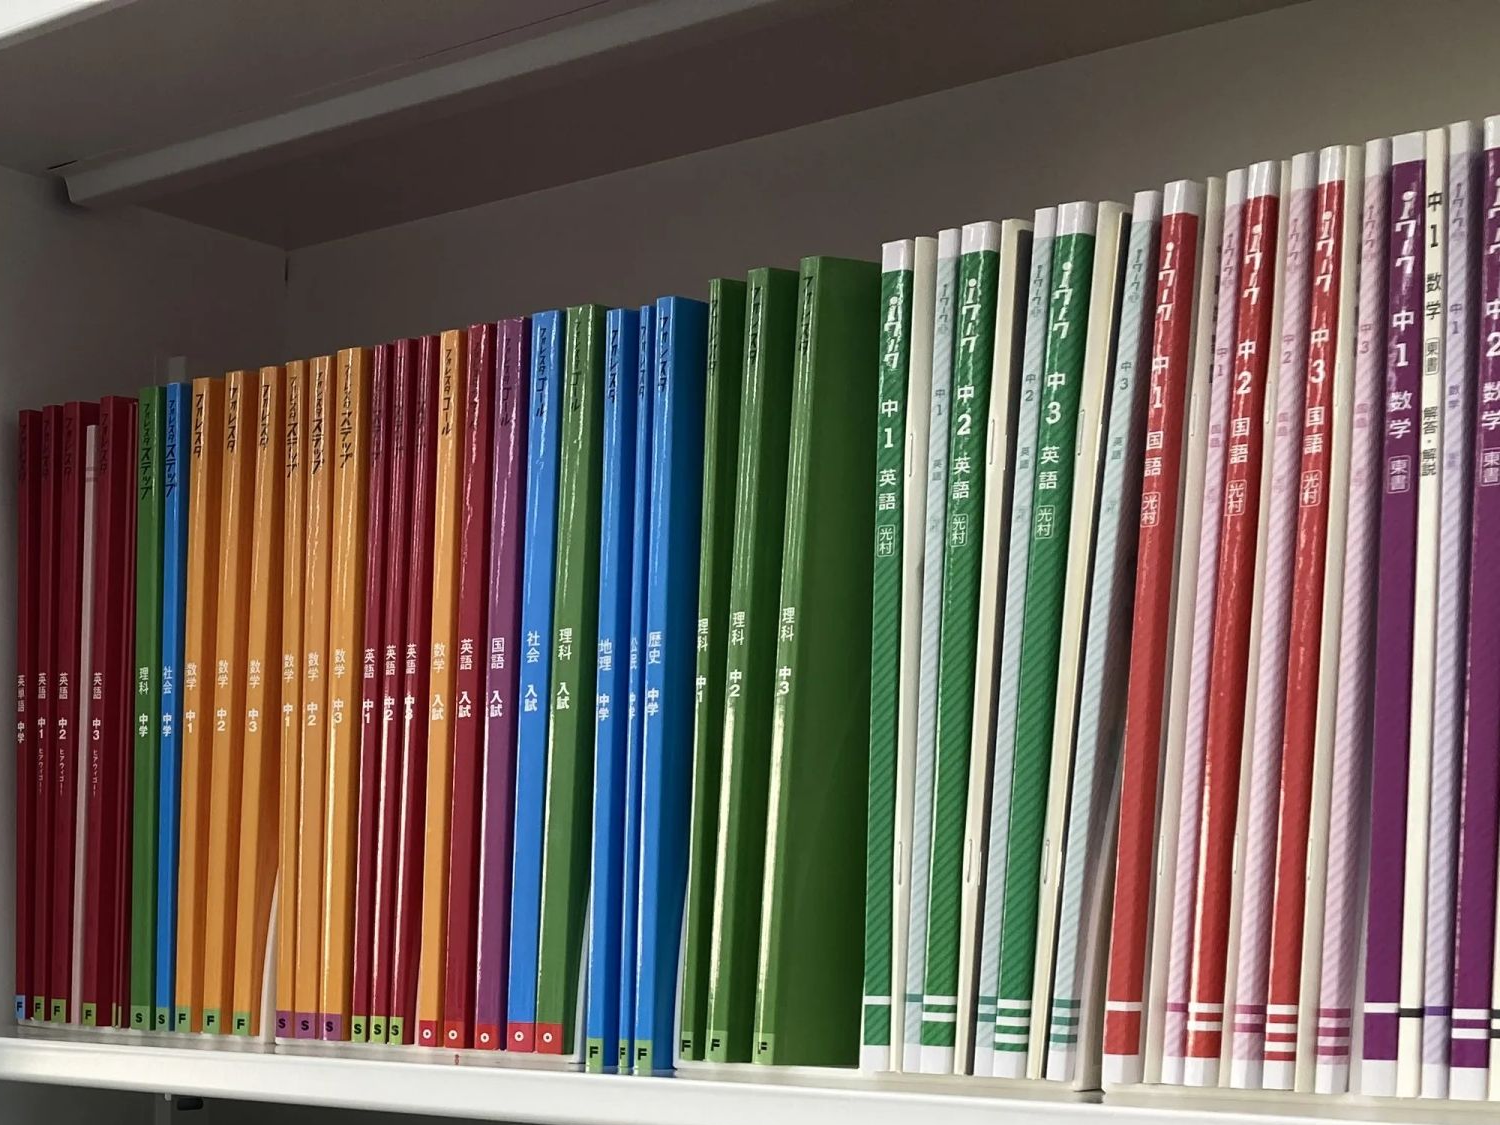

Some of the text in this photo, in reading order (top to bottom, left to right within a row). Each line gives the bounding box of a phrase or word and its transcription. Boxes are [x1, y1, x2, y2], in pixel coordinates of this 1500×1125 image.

[1309, 329, 1329, 384] 中3
[1392, 310, 1414, 367] 中1
[1237, 341, 1256, 395] 中2
[952, 278, 981, 544] iワーク 中2 英語 光村
[1037, 261, 1072, 537] iワーク 中3 英語 光村
[1388, 391, 1412, 439] 数学
[1230, 418, 1250, 464] 国語
[1304, 406, 1325, 455] 国語
[1144, 432, 1163, 477] 国語
[879, 400, 898, 555] 中1 英語 光村
[334, 649, 346, 678] 数学
[433, 643, 445, 673] 数学
[460, 639, 473, 670] 英語
[556, 628, 572, 710] 理科 入試
[599, 638, 612, 671] 地理
[648, 631, 662, 664] 歴史
[729, 612, 745, 697] 理科 中2
[779, 607, 795, 694] 理科 中3
[38, 673, 46, 699] 英語
[59, 673, 68, 699] 英語
[139, 667, 149, 695] 理科
[163, 666, 172, 694] 社会
[217, 660, 228, 688] 数学
[249, 660, 261, 688] 数学
[490, 638, 504, 717] 国語 入試
[524, 631, 540, 712] 社会 入試
[58, 717, 67, 740] 中2
[93, 672, 102, 740] 英語 中3
[179, 394, 203, 1024] フォレスタ 数学 中1 F
[217, 708, 227, 731] 中2
[248, 708, 258, 732] 中3
[278, 654, 294, 1028] 数学 S
[301, 653, 320, 1030] 数学 S
[136, 1013, 142, 1023] S
[158, 1014, 165, 1024] S
[207, 1016, 214, 1026] F
[354, 1024, 361, 1034] S
